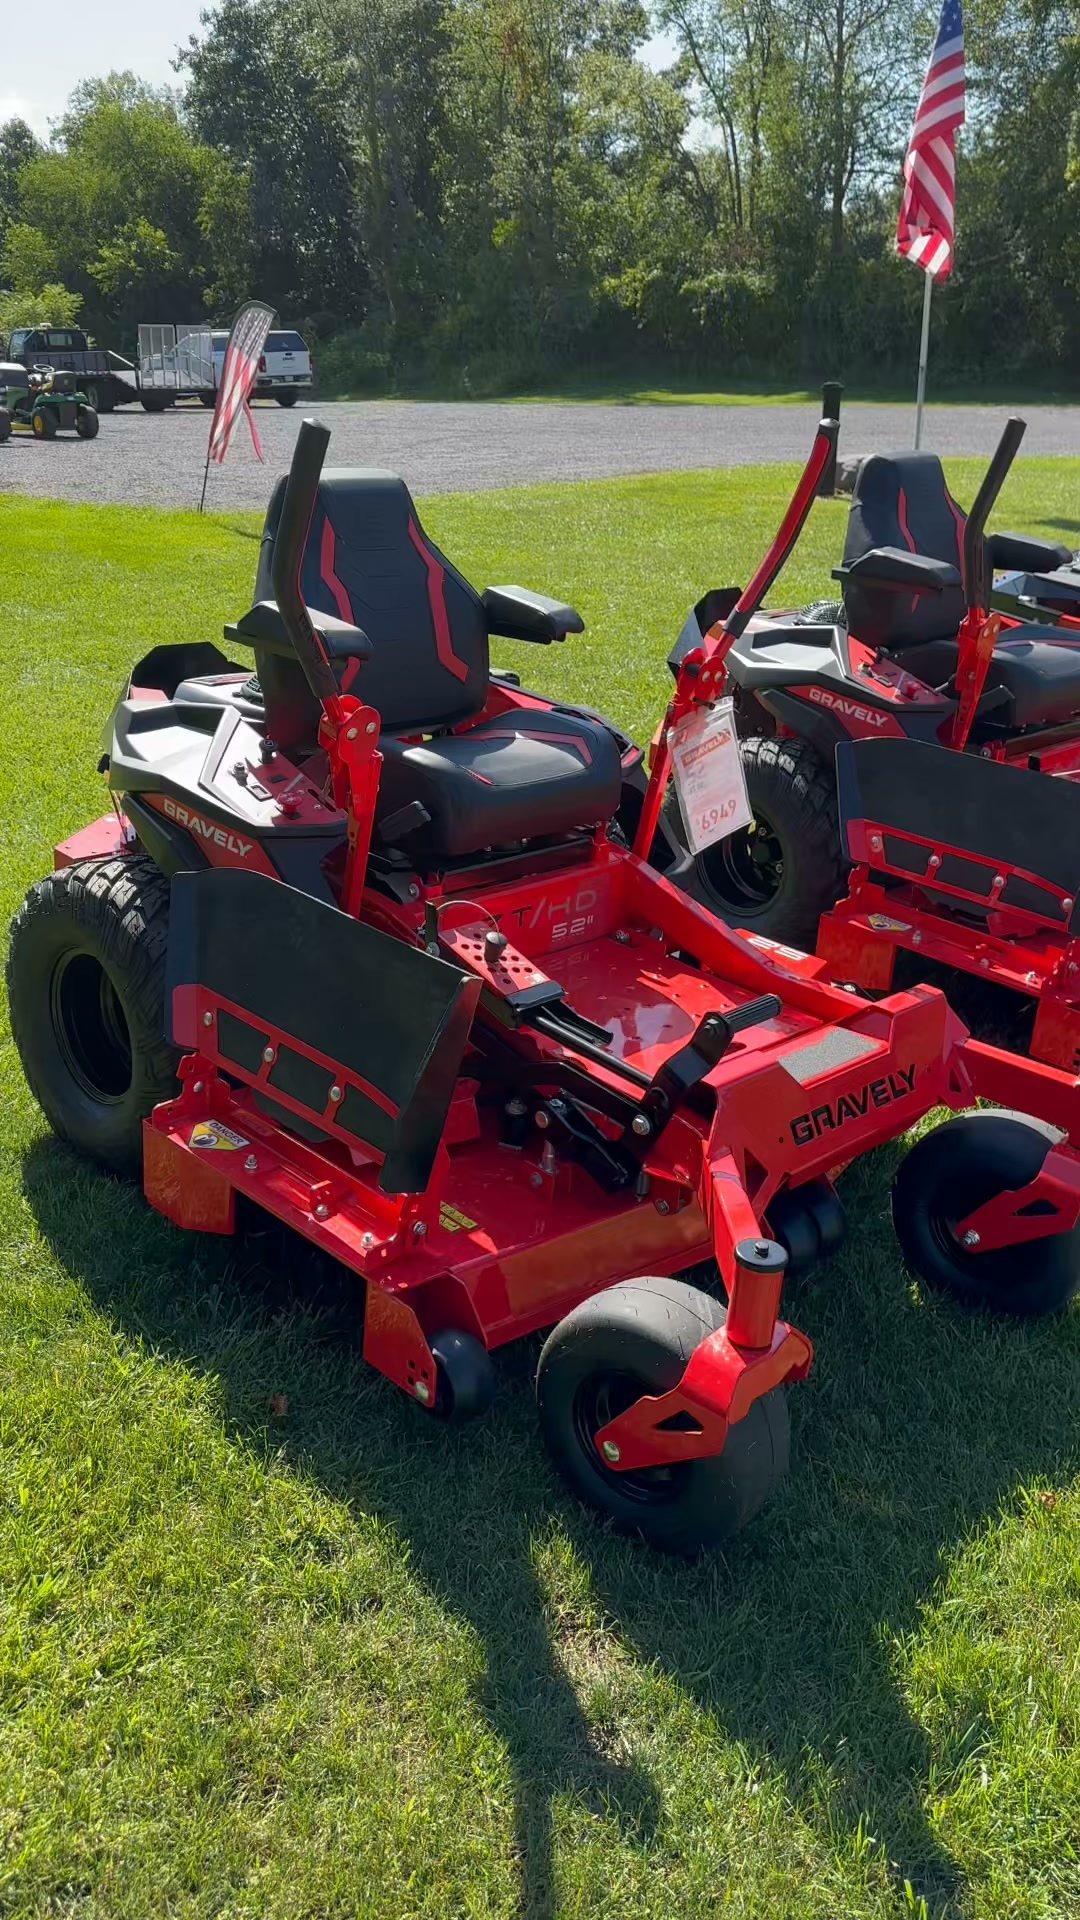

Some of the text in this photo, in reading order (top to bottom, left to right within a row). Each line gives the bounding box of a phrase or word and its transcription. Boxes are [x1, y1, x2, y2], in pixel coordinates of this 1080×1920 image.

[808, 688, 888, 727] GRAVELY
[163, 798, 253, 857] GRAVELY
[790, 1063, 916, 1147] GRAVELY
[209, 1122, 244, 1144] DANGER
